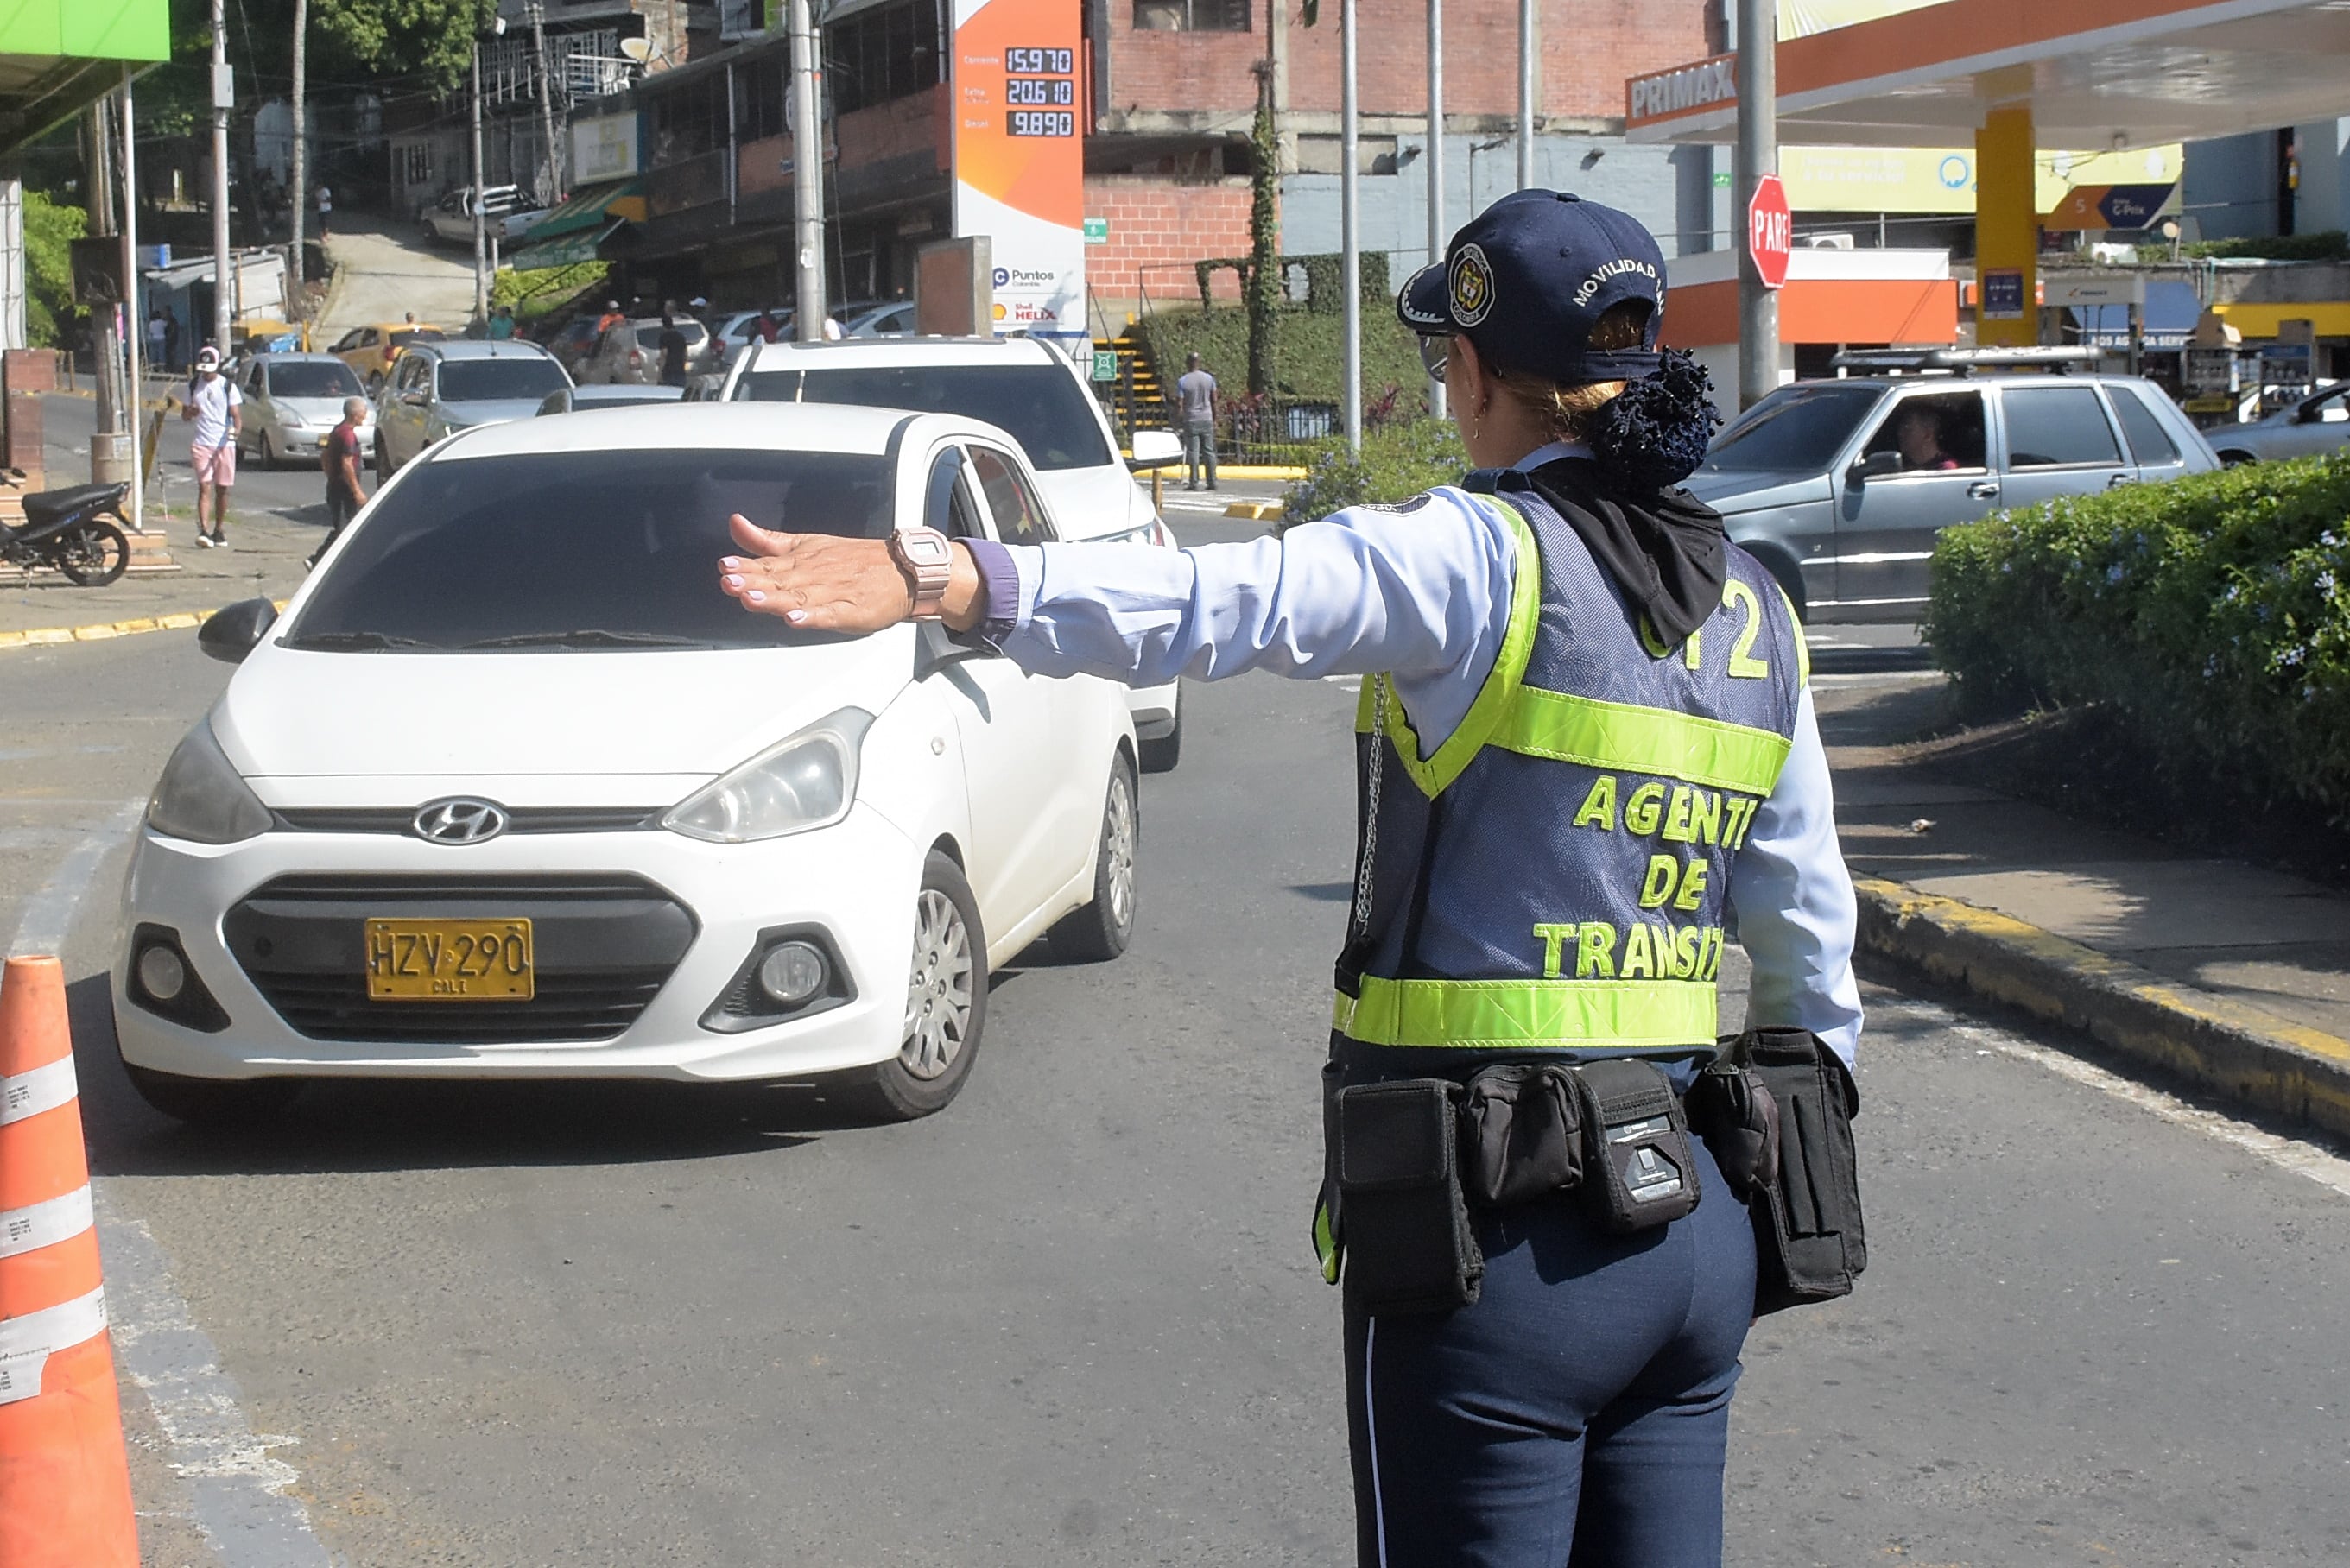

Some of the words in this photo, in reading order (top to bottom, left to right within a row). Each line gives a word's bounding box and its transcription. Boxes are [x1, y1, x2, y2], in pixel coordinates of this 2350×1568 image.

[1007, 49, 1071, 73] 15.970
[1008, 80, 1072, 104] 20.610
[1631, 57, 1737, 119] PRIMAX
[1015, 112, 1072, 136] 9.890
[1754, 209, 1788, 254] PARE
[1012, 269, 1055, 281] Puntos
[1572, 259, 1656, 307] MOVILIDAD
[1015, 311, 1057, 320] HELIX
[1638, 854, 1707, 911] DE
[373, 933, 443, 977] HZV
[455, 933, 526, 977] 290
[433, 979, 467, 994] CALI
